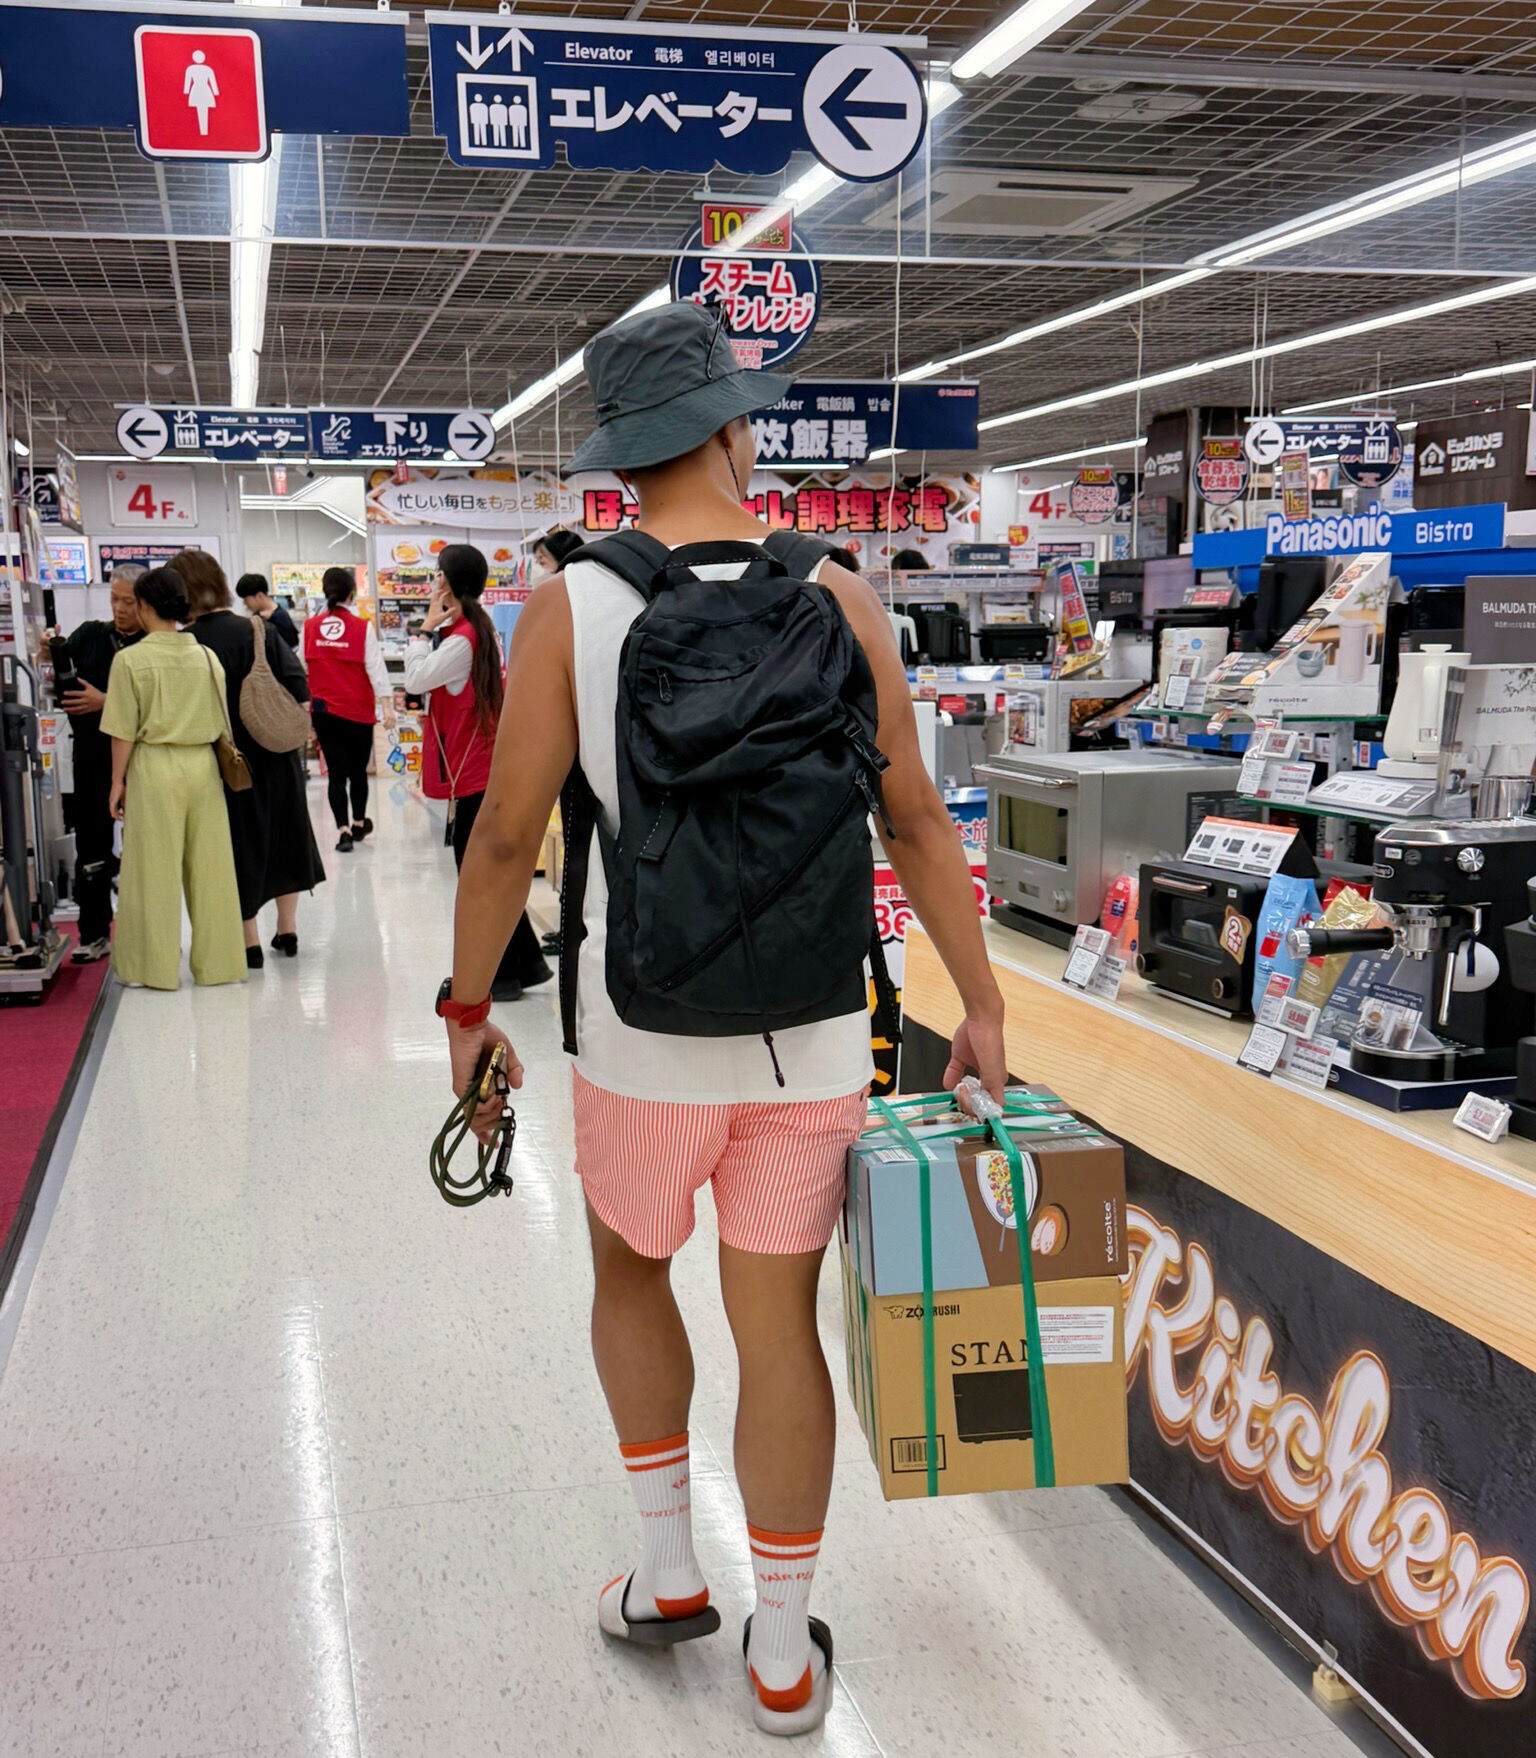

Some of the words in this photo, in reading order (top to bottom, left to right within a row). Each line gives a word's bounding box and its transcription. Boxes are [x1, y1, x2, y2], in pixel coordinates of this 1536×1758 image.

[565, 42, 633, 61] Elevator
[654, 47, 684, 63] 電梯
[704, 49, 775, 68] 엘리베이터
[550, 86, 792, 138] エレベーター
[703, 261, 793, 294] スチーム
[205, 428, 305, 449] エレベーター
[374, 414, 427, 444] 下り
[752, 419, 868, 459] 炊飯器
[361, 444, 445, 457] エスカレーター
[1286, 434, 1362, 450] エレベーター
[1447, 432, 1503, 455] ビックカメラ
[1451, 452, 1496, 473] リフォーム
[127, 484, 174, 519] 4F
[397, 491, 573, 512] 忙しい毎日をもっと楽に!
[1267, 505, 1392, 555] Panasonic
[1416, 520, 1473, 545] Bistro
[1482, 602, 1526, 614] BALMUDA
[1104, 1200, 1114, 1263] récolte
[905, 1304, 961, 1321] ZORUSHI
[1125, 1204, 1529, 1699] Kitchen
